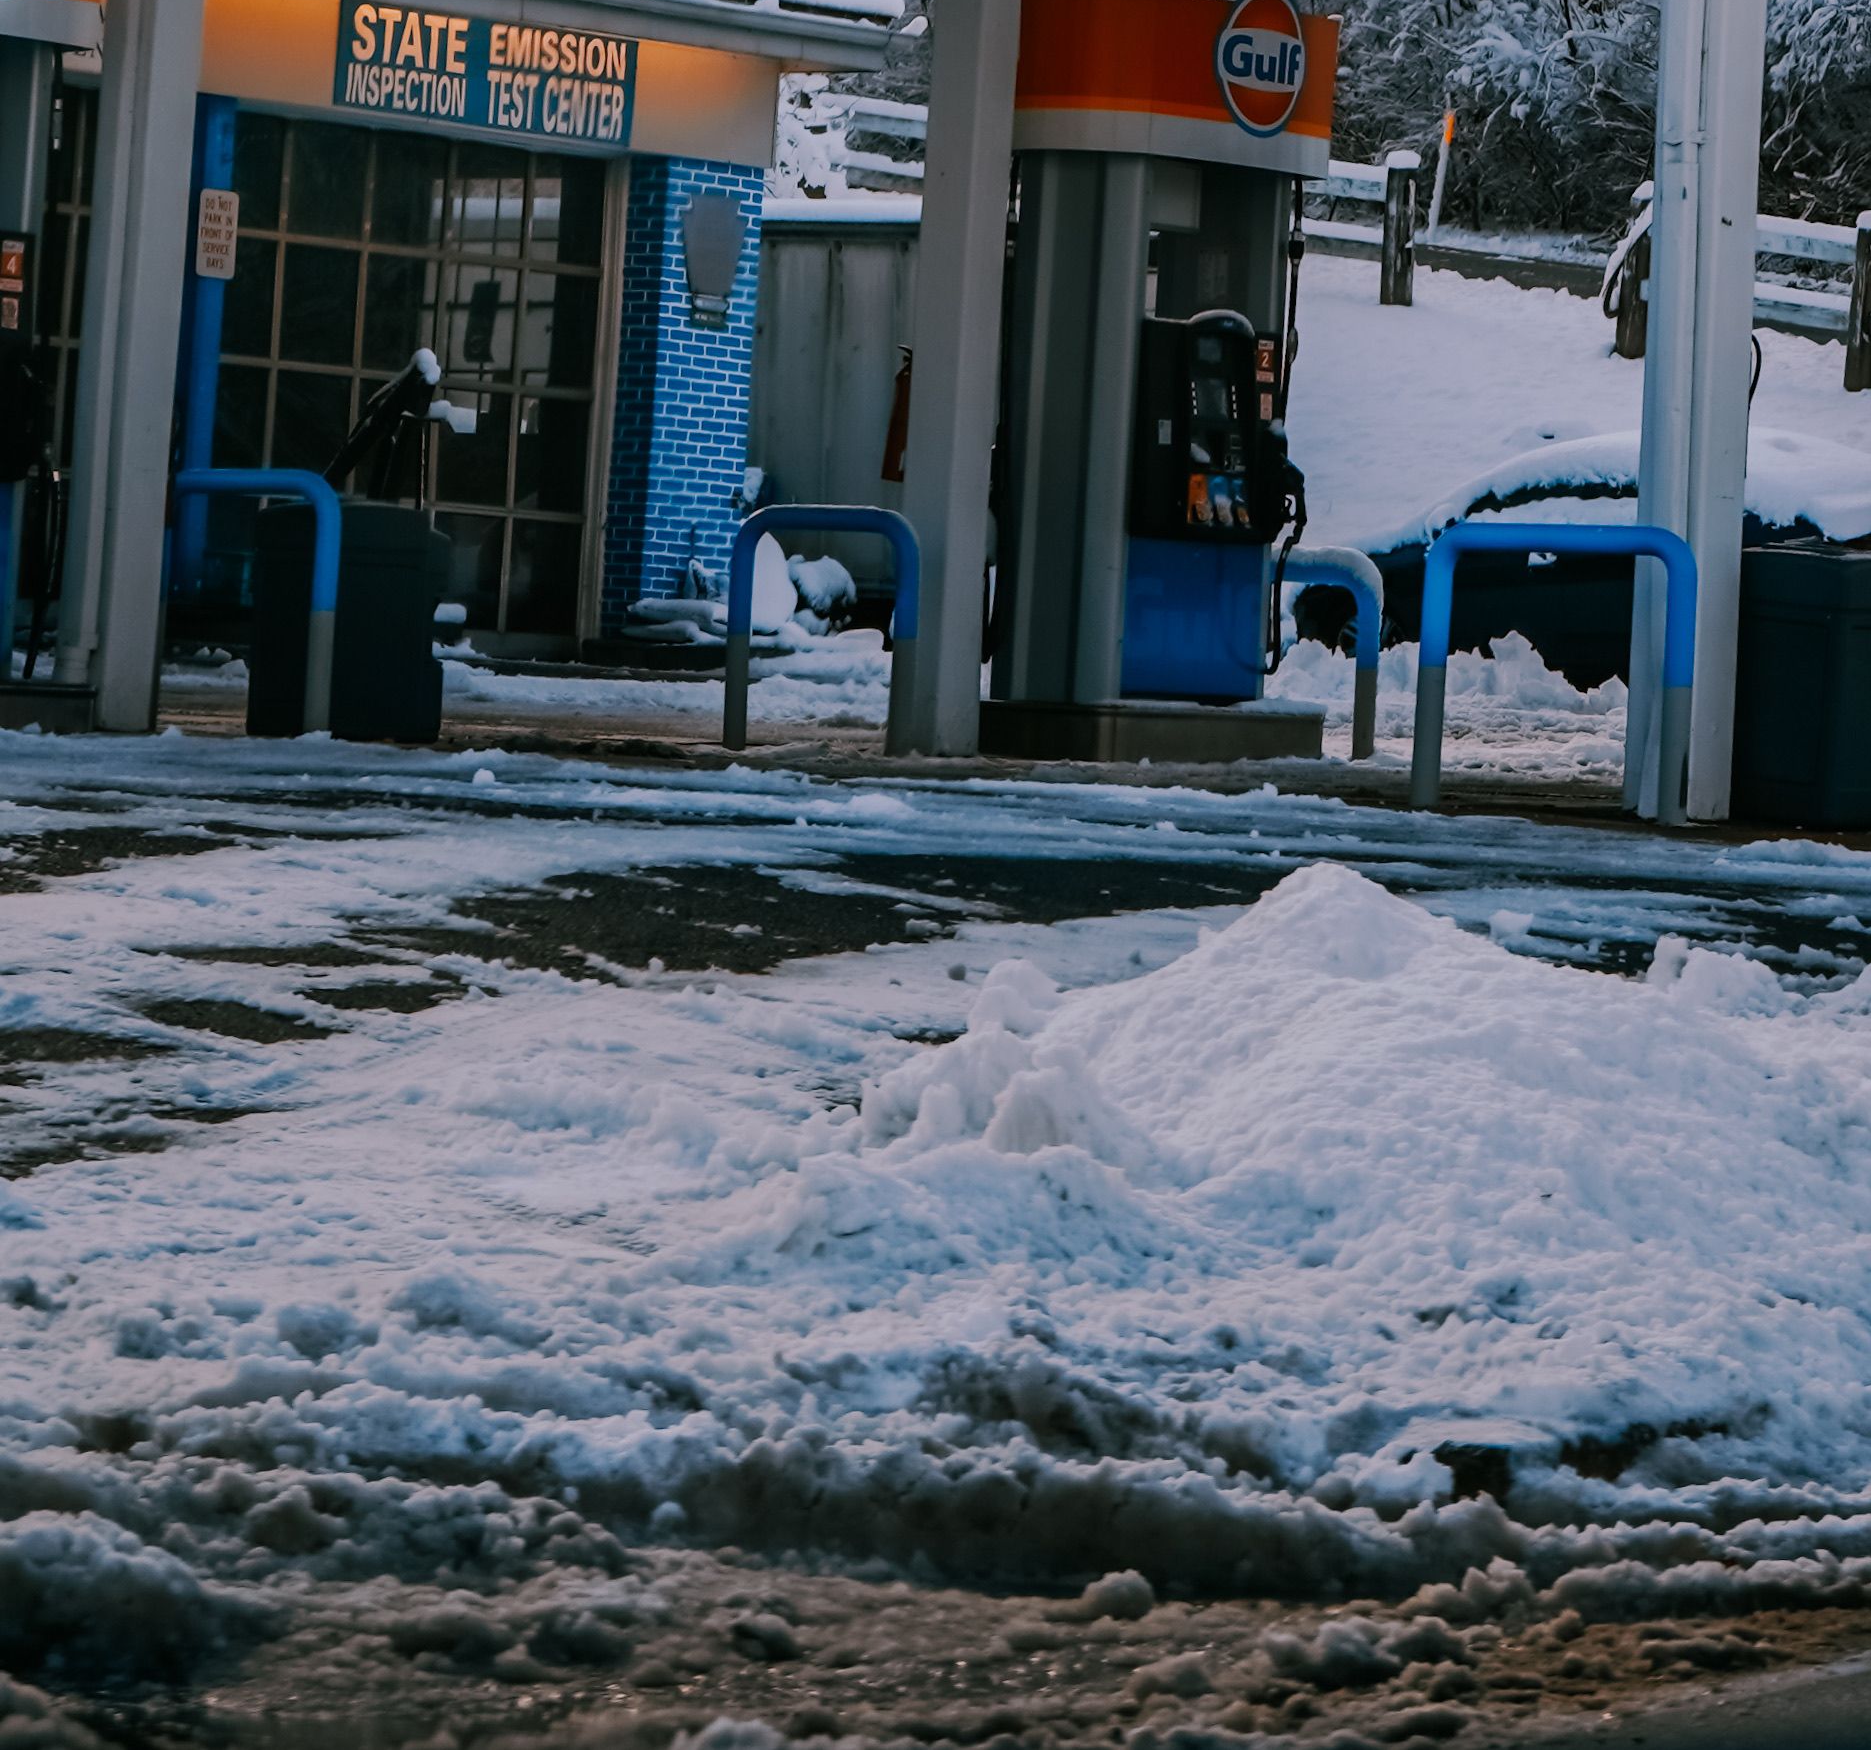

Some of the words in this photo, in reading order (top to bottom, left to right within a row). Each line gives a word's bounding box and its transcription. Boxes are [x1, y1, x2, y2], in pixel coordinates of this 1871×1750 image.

[352, 3, 469, 75] STATE
[489, 23, 627, 80] EMISSION
[1222, 34, 1302, 86] Gulf
[345, 62, 467, 118] INSPECTION
[487, 69, 540, 130] TEST
[542, 74, 625, 141] CENTER
[1262, 351, 1270, 368] 2
